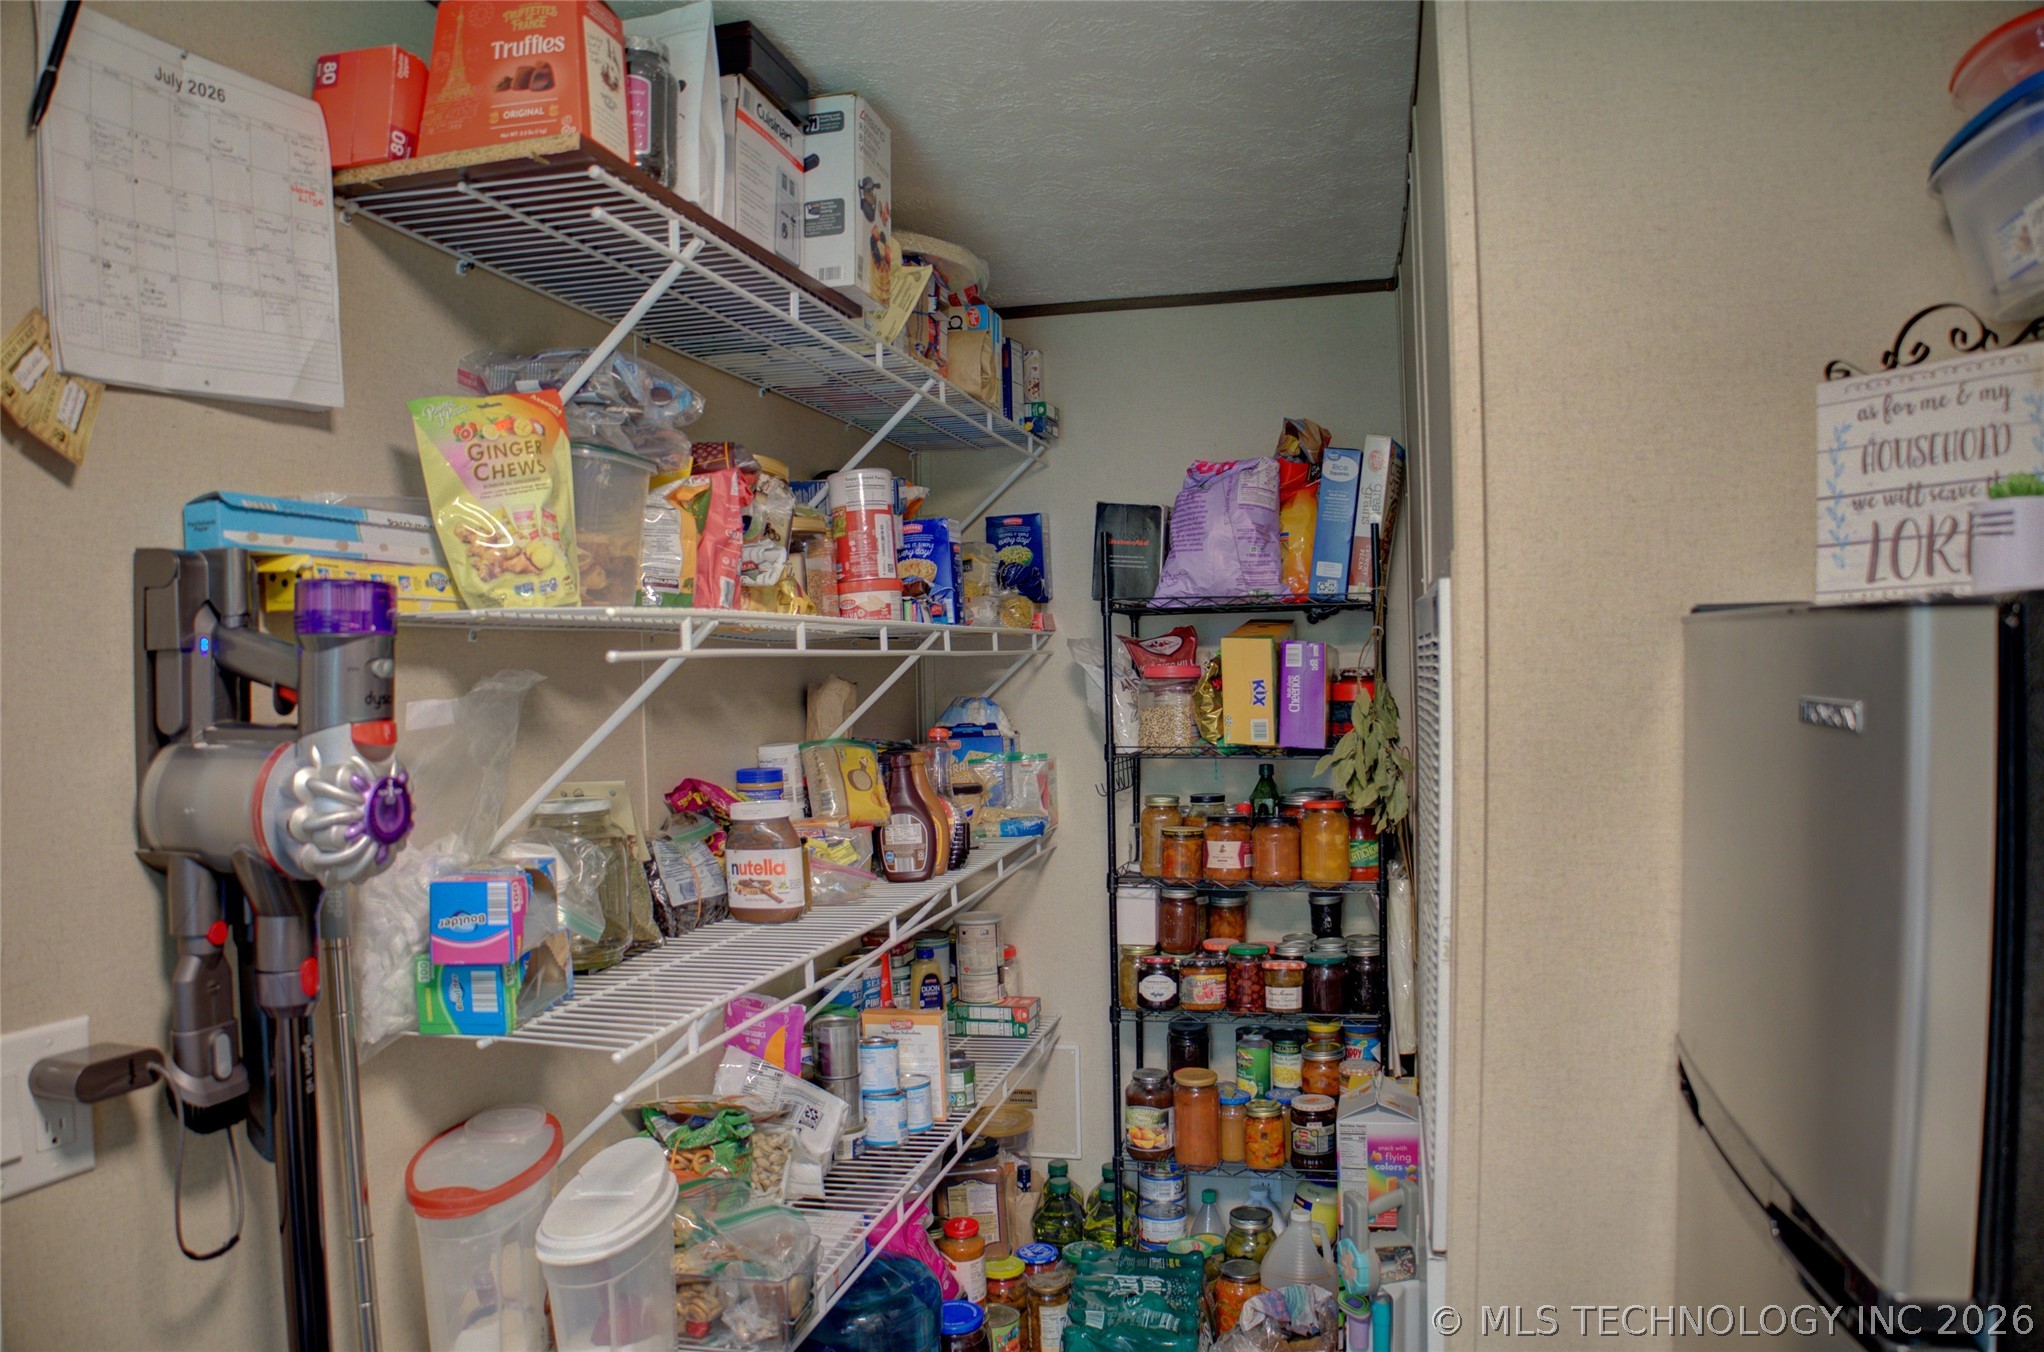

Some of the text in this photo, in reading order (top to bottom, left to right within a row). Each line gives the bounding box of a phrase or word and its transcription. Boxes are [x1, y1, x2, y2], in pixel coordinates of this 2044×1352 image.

[490, 34, 565, 59] Truffles
[155, 66, 226, 103] July 2026
[322, 61, 338, 85] 80
[503, 107, 545, 119] ORIGINAL
[756, 102, 793, 148] Cuisinart
[390, 130, 406, 156] 80
[1857, 406, 1878, 422] as
[1883, 393, 1916, 424] for
[1920, 394, 1950, 411] me
[1980, 383, 2013, 413] my
[467, 440, 542, 462] GINGER
[1861, 423, 2012, 475] HOUSEHOLD
[473, 459, 546, 481] CHEWS
[1332, 463, 1348, 472] Rice
[1361, 485, 1372, 525] grains
[1852, 496, 1876, 511] we
[1883, 482, 1923, 508] will
[1928, 484, 1979, 502] serve
[1288, 675, 1301, 713] Cheerios
[731, 858, 786, 876] nutella
[438, 912, 486, 929] Boulder
[420, 961, 430, 981] 100
[451, 973, 464, 1012] Boulder
[301, 1034, 313, 1076] dyson
[1375, 1163, 1402, 1171] colors
[1385, 1152, 1412, 1164] flying
